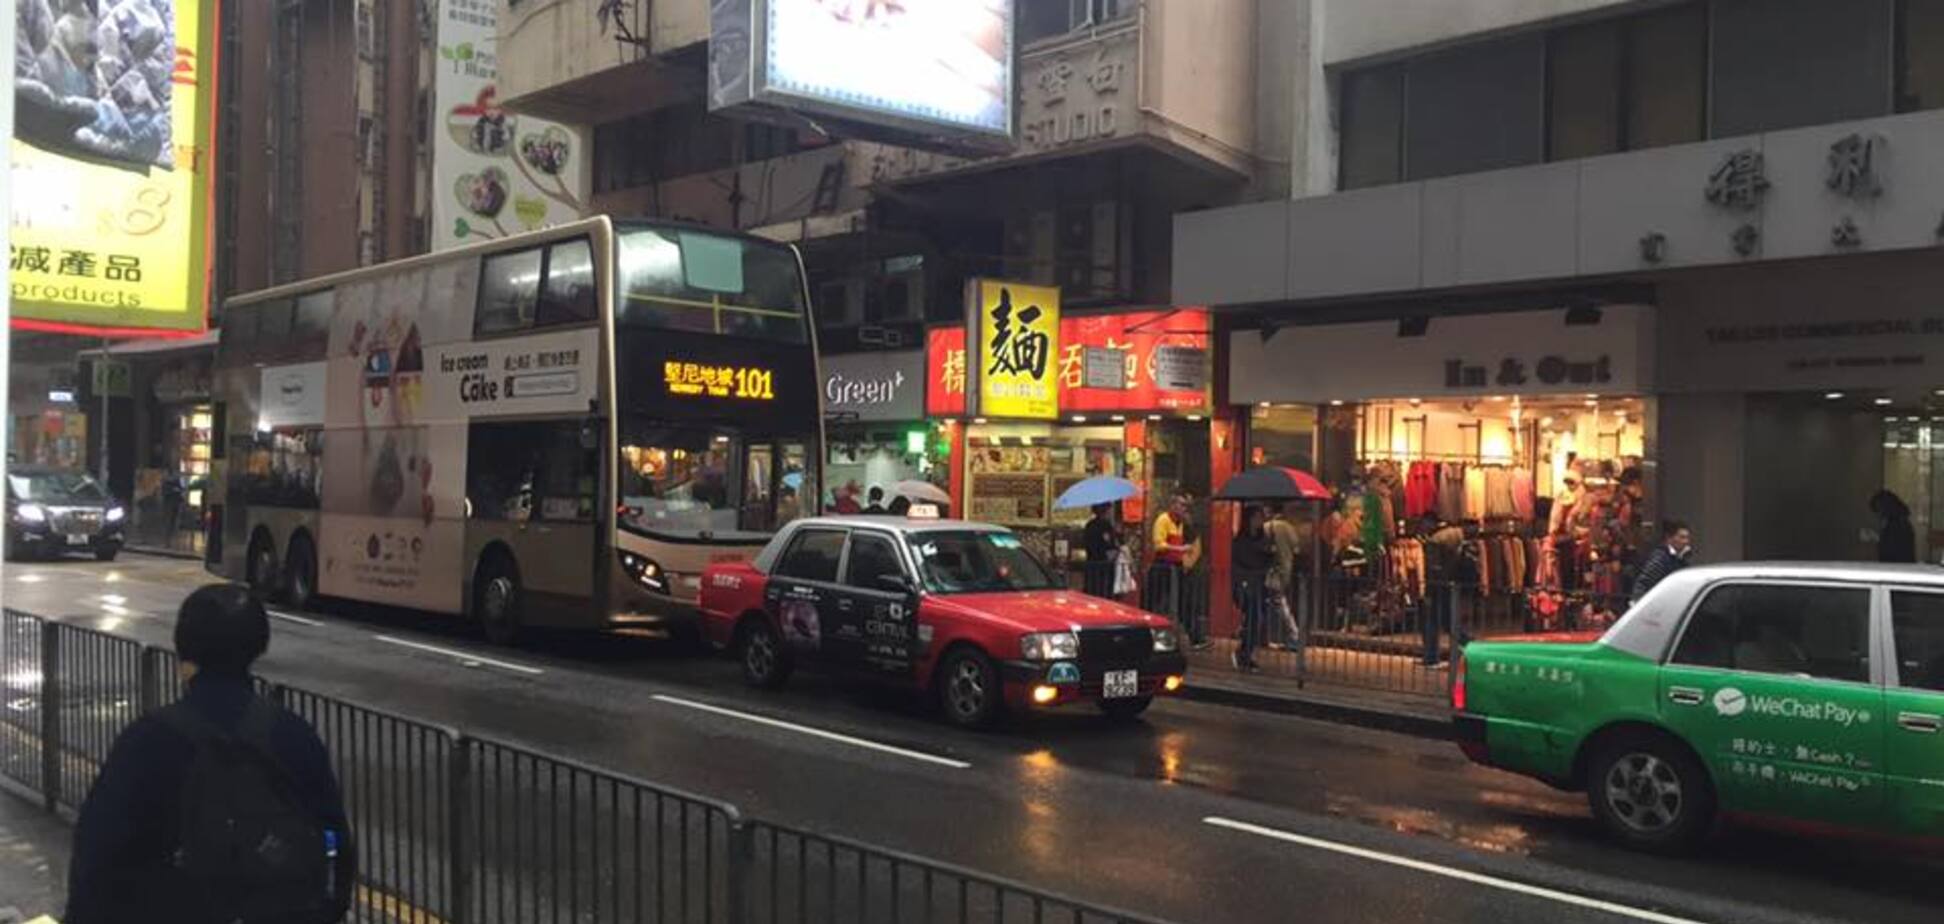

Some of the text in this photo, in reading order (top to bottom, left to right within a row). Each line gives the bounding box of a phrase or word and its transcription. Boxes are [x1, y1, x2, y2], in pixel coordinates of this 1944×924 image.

[1024, 105, 1117, 149] STUDIO
[735, 368, 774, 399] 101
[1445, 355, 1612, 388] In & Out
[1751, 695, 1821, 719] WeChat
[1824, 702, 1857, 726] Pay
